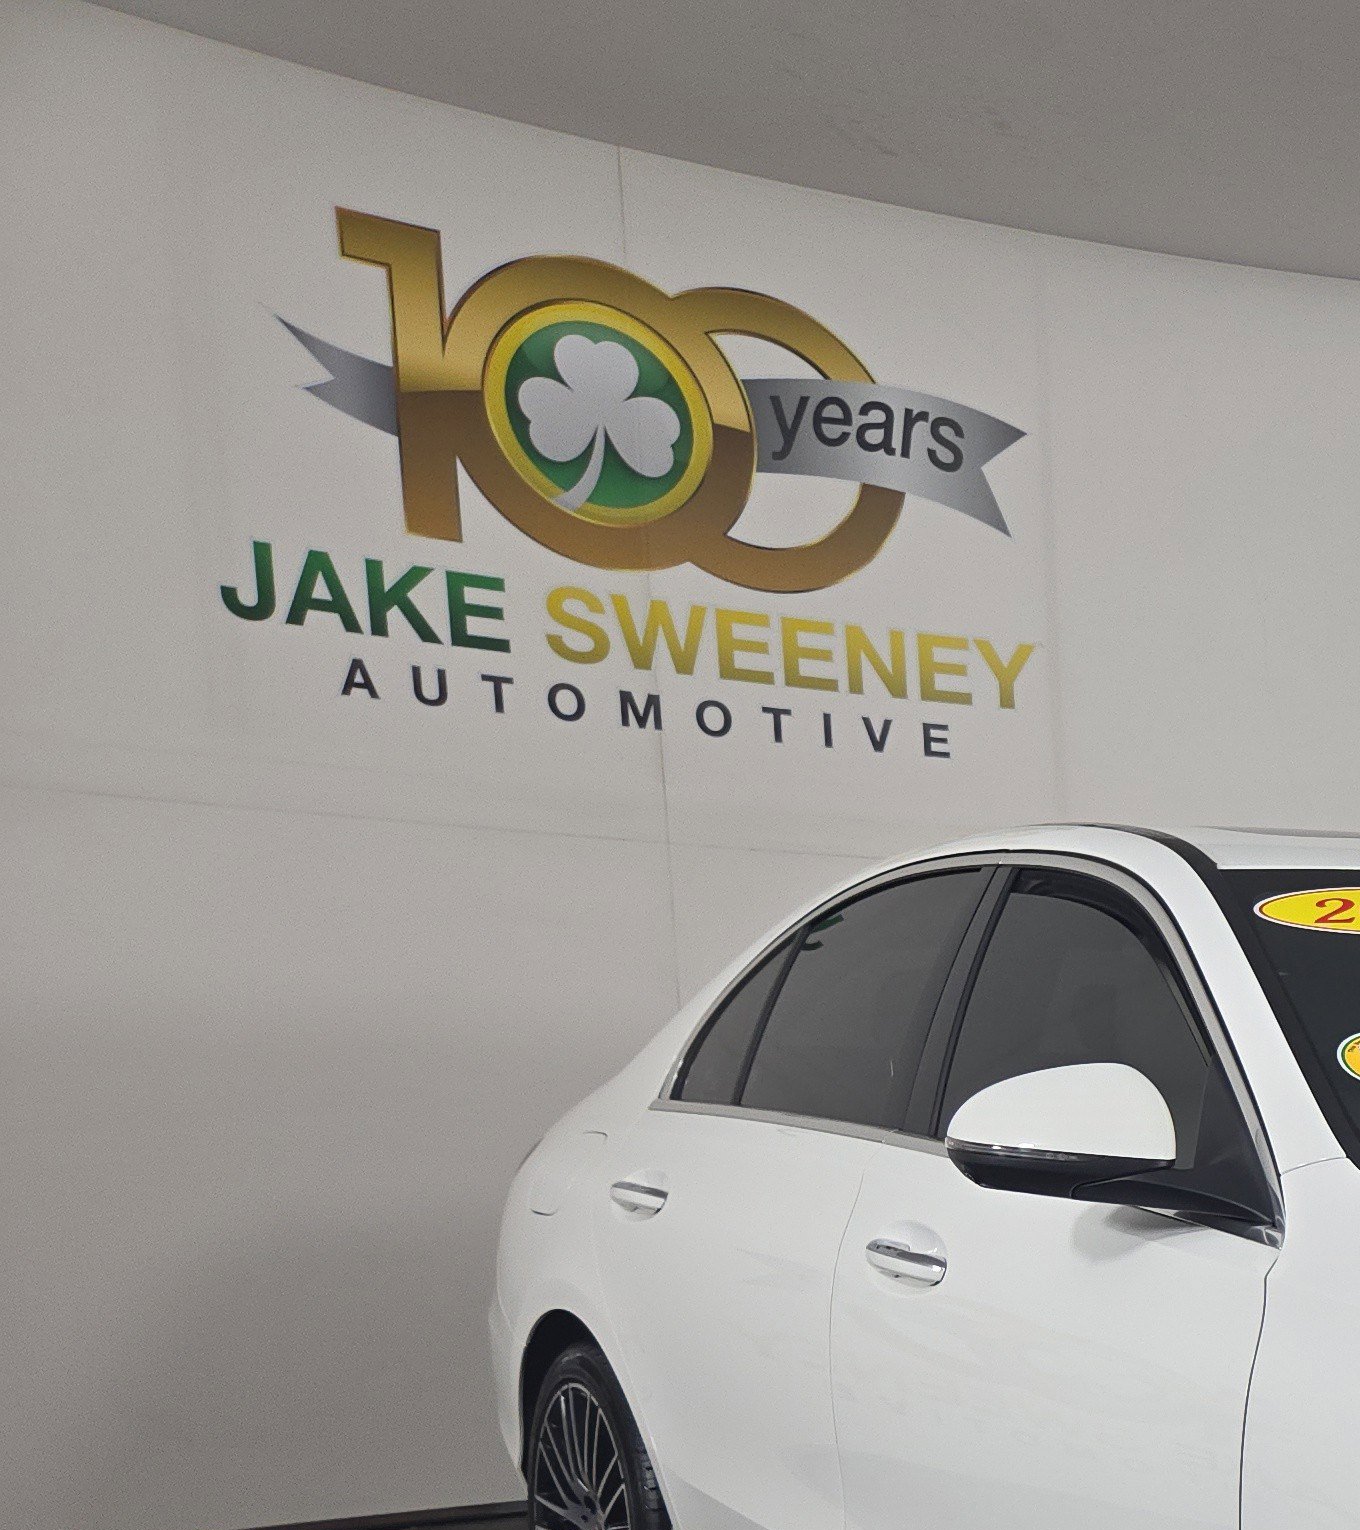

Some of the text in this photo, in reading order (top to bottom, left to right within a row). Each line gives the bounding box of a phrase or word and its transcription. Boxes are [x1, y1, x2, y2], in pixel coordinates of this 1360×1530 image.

[769, 391, 967, 473] years
[220, 540, 1036, 710] JAKE SWEENEY
[341, 658, 953, 758] AUTOMOTIVE
